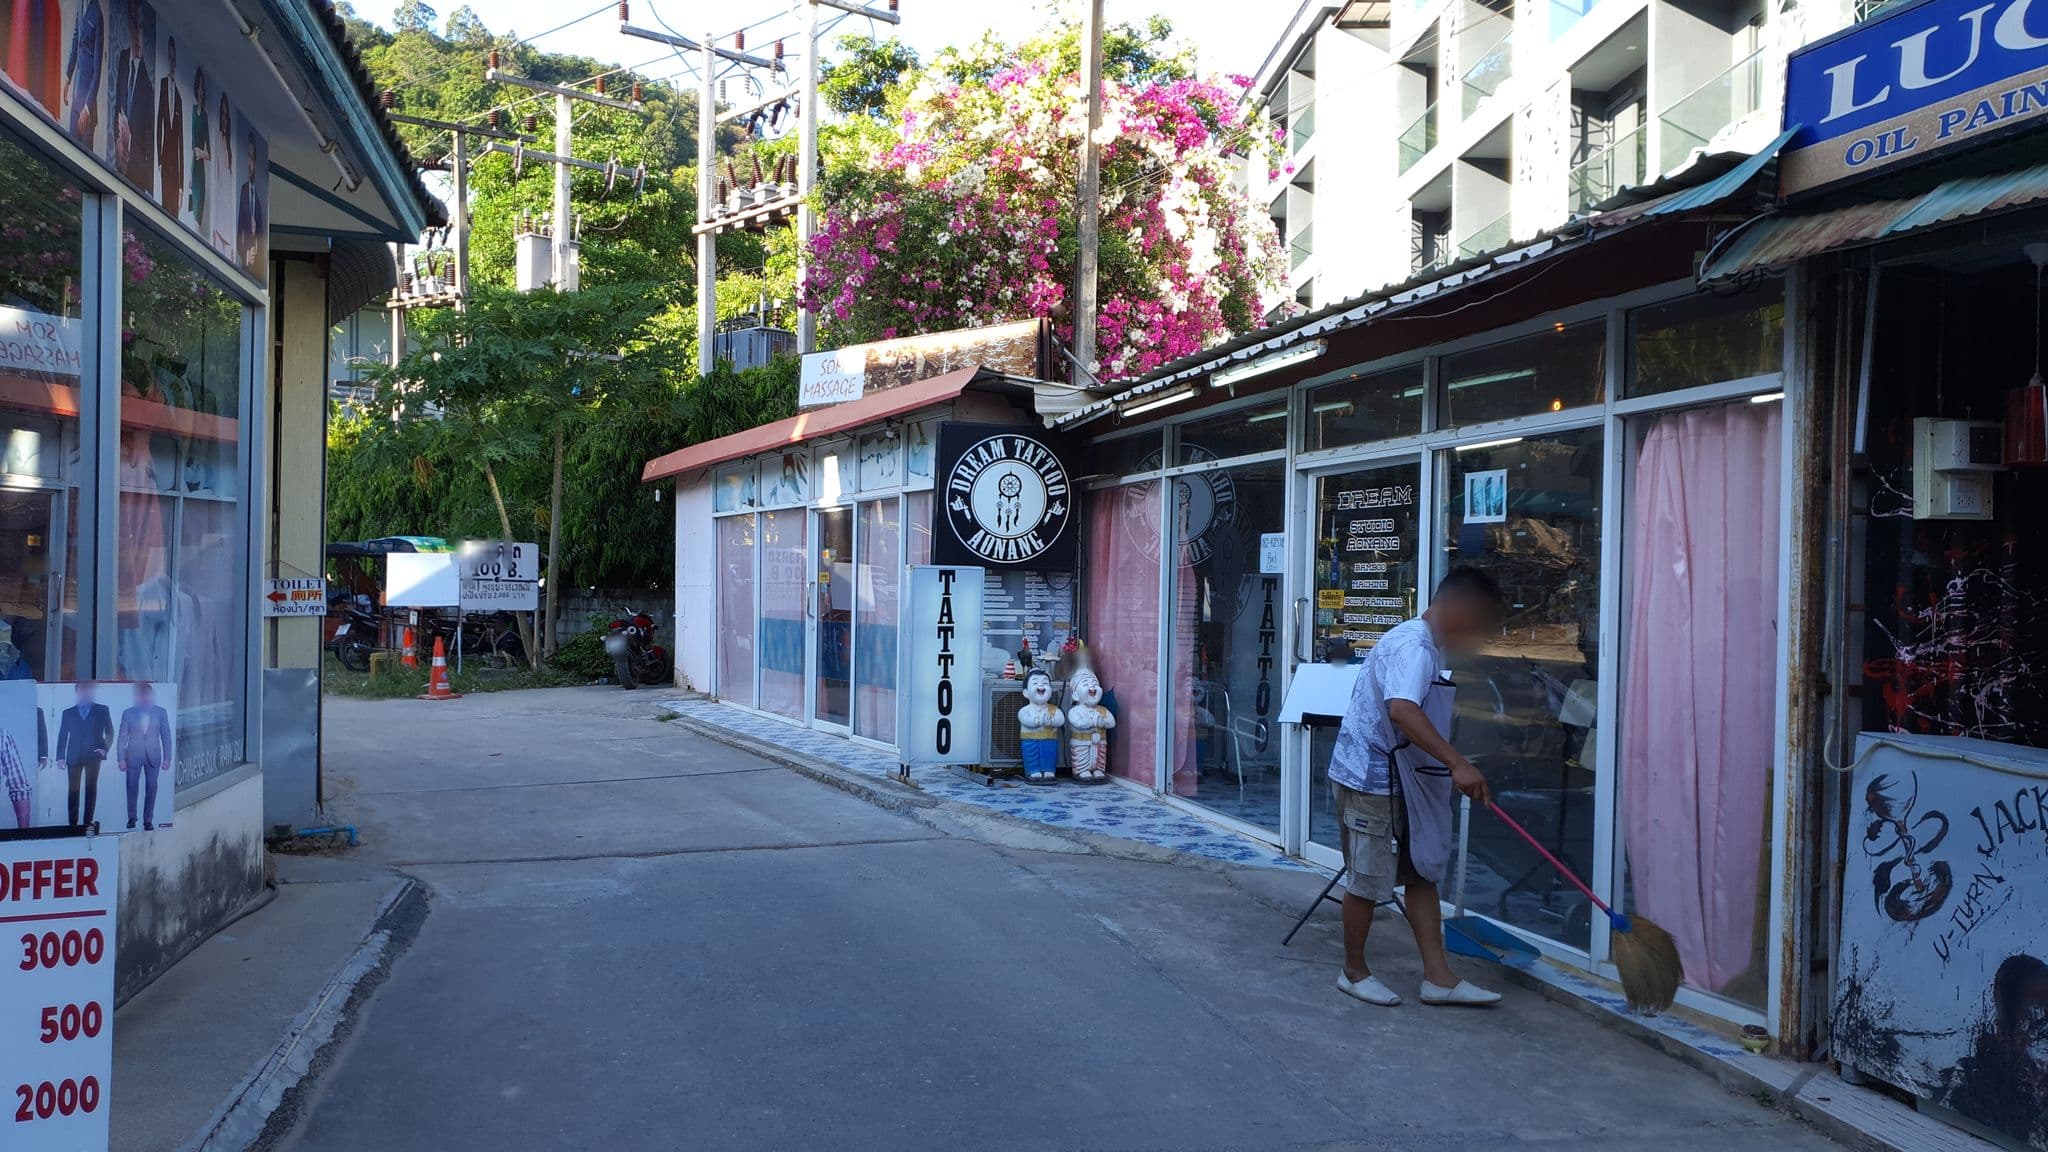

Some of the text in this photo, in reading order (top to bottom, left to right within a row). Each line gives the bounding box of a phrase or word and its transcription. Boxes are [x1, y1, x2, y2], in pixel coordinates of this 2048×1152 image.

[1843, 127, 1916, 166] OIL
[803, 377, 857, 400] MASSAGE
[951, 439, 1007, 493] DREAM
[1014, 439, 1067, 496] TATTOO
[1338, 485, 1413, 510] DREAM
[1350, 518, 1394, 533] STUDIO
[966, 529, 1045, 560] AONANG
[1346, 536, 1400, 551] AONANG
[1354, 563, 1387, 573] BAMBOO
[271, 579, 324, 590] TOILET
[1352, 580, 1389, 590] MACHINE
[1344, 597, 1364, 607] BODY
[1364, 597, 1403, 608] PAINTING
[1343, 613, 1372, 623] HENNA
[1372, 615, 1402, 625] TATTOO
[936, 569, 957, 755] TATTOO
[1933, 862, 2006, 965] U-TURN
[19, 928, 105, 971] 3000
[40, 1001, 103, 1044] 500
[15, 1075, 100, 1123] 2000
